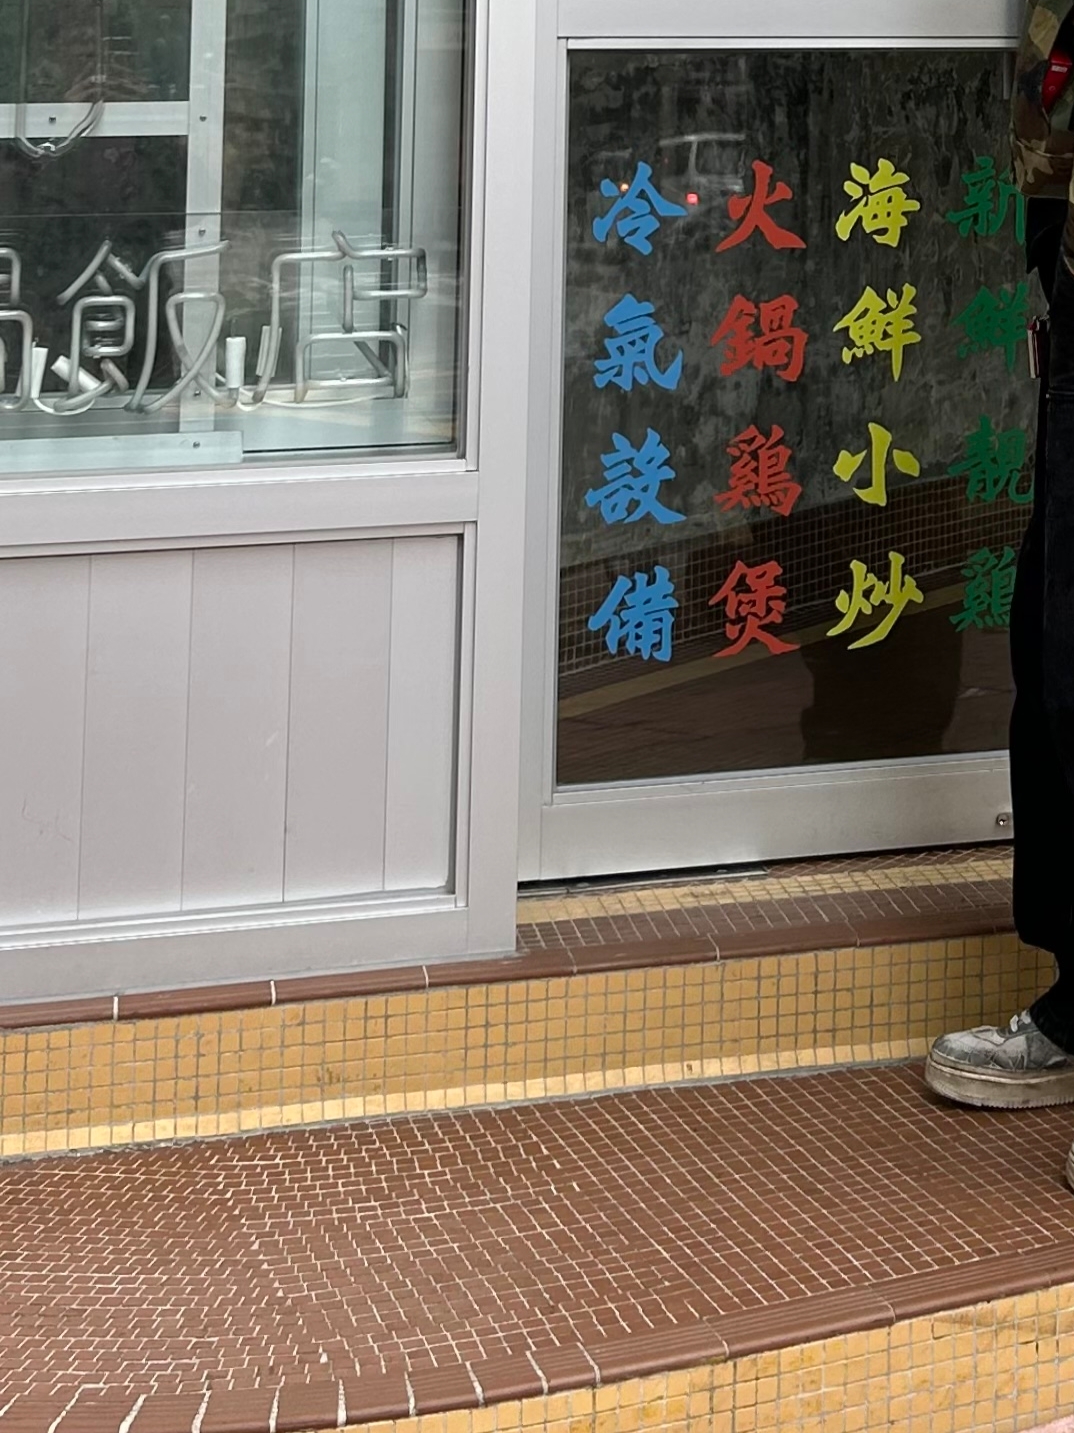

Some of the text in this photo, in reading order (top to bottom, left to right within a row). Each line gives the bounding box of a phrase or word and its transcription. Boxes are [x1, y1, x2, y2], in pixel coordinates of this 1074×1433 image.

[0, 229, 428, 416] 飯店
[584, 160, 689, 662] 冷氣設備
[826, 157, 924, 651] 海鮮小炒
